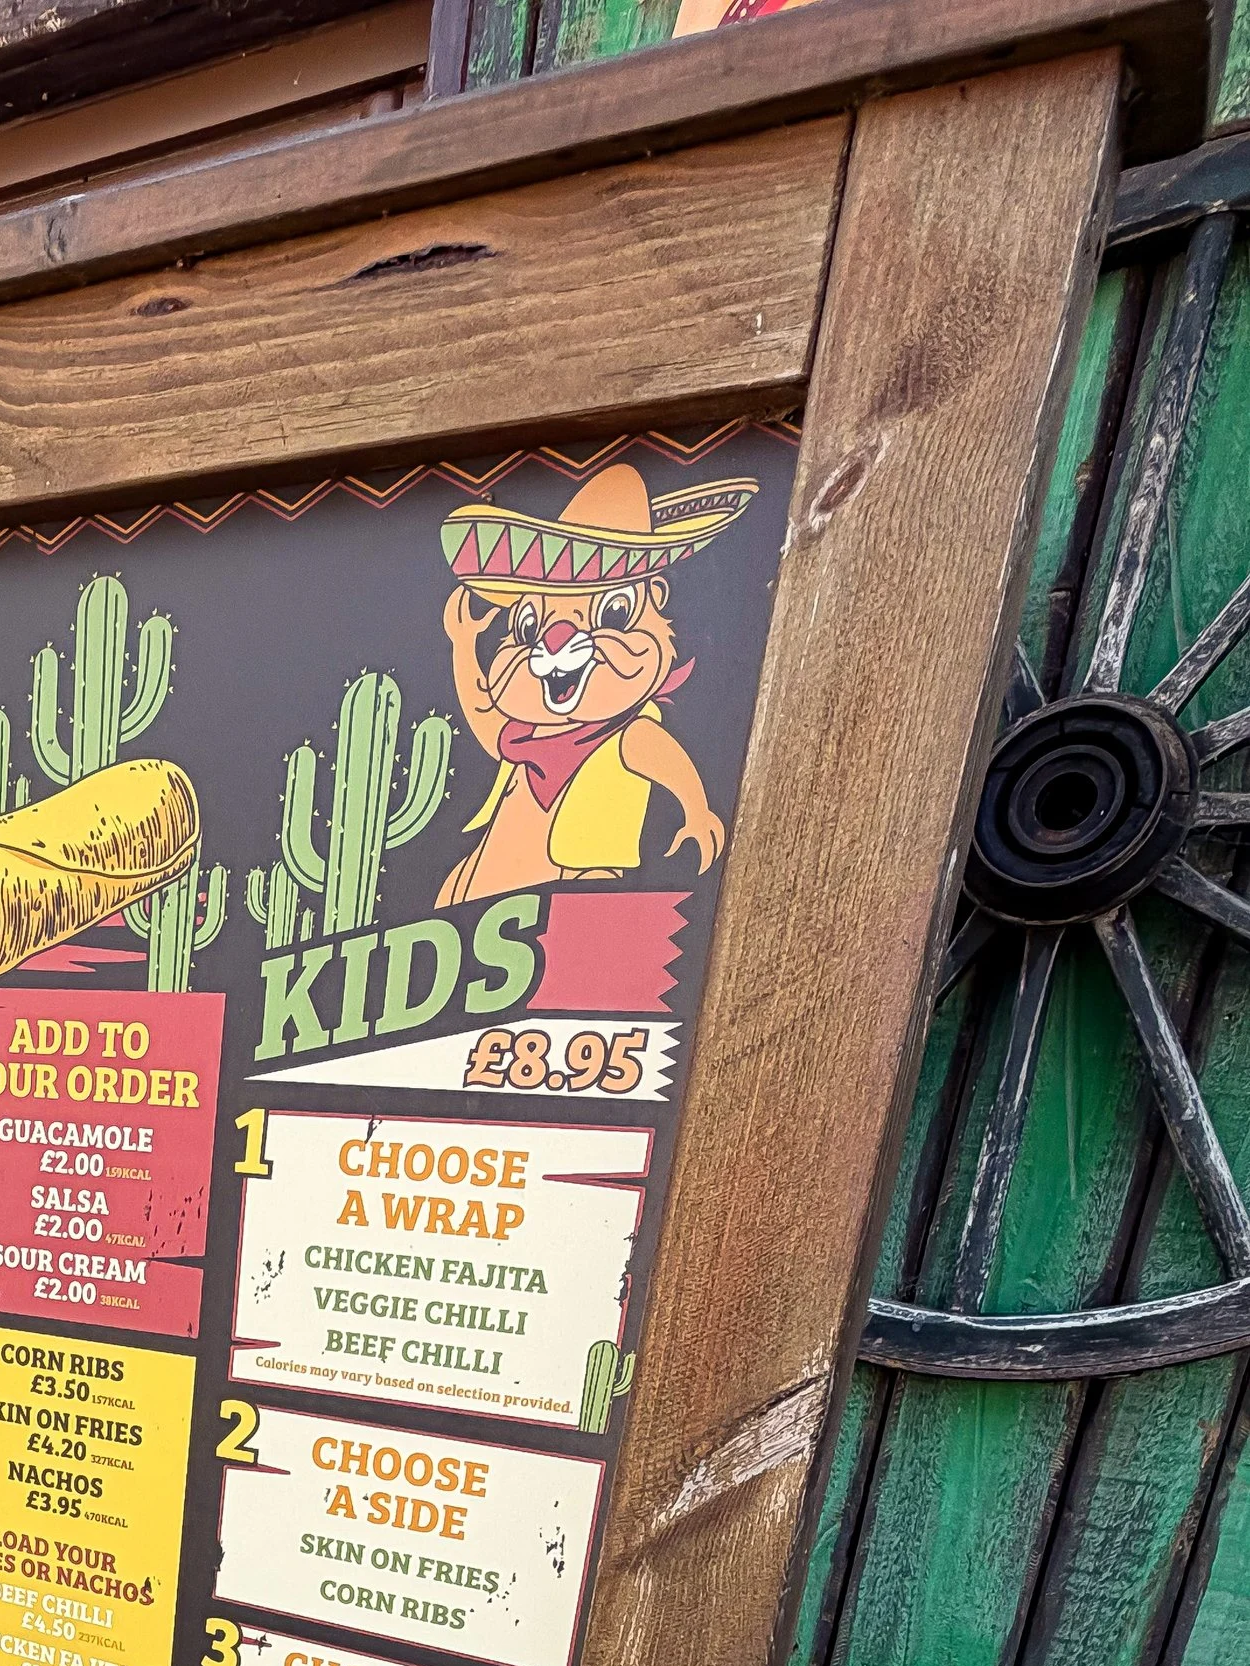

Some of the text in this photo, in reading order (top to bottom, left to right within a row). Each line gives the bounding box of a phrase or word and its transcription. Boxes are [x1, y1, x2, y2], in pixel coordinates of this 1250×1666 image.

[254, 894, 541, 1062] KIDS
[9, 1019, 149, 1059] ADD TO
[463, 1028, 649, 1093] £8.95
[67, 1065, 199, 1107] ORDER
[39, 1150, 103, 1176] £2.00
[338, 1139, 530, 1190] CHOOSE
[31, 1185, 109, 1215] SALSA
[336, 1190, 525, 1240] A WRAP
[33, 1214, 102, 1241] £2.00
[58, 1252, 146, 1284] CREAM
[304, 1245, 548, 1294] CHICKEN FAJITA
[33, 1277, 97, 1304] £2.00
[313, 1287, 528, 1336] VEGGIE CHILLI
[1, 1344, 124, 1382] CORN RIBS
[326, 1330, 503, 1375] BEEF CHILLI
[30, 1375, 90, 1401] £3.50
[256, 1356, 574, 1414] Calories may vary based on selection provided.
[27, 1433, 86, 1461] £4.20
[37, 1409, 70, 1432] ON
[75, 1415, 142, 1446] FRIES
[8, 1461, 103, 1498] NACHOS
[312, 1436, 490, 1498] CHOOSE
[26, 1491, 128, 1528] £3.95 470KCAL
[327, 1485, 467, 1540] A SIDE
[54, 1541, 116, 1574] YOUR
[300, 1533, 500, 1593] SKIN ON FRIES
[21, 1559, 50, 1582] OR
[55, 1566, 154, 1605] NACHOS
[42, 1595, 113, 1628] CHILLI
[320, 1580, 467, 1630] CORN RIBS
[21, 1612, 76, 1640] £4.50
